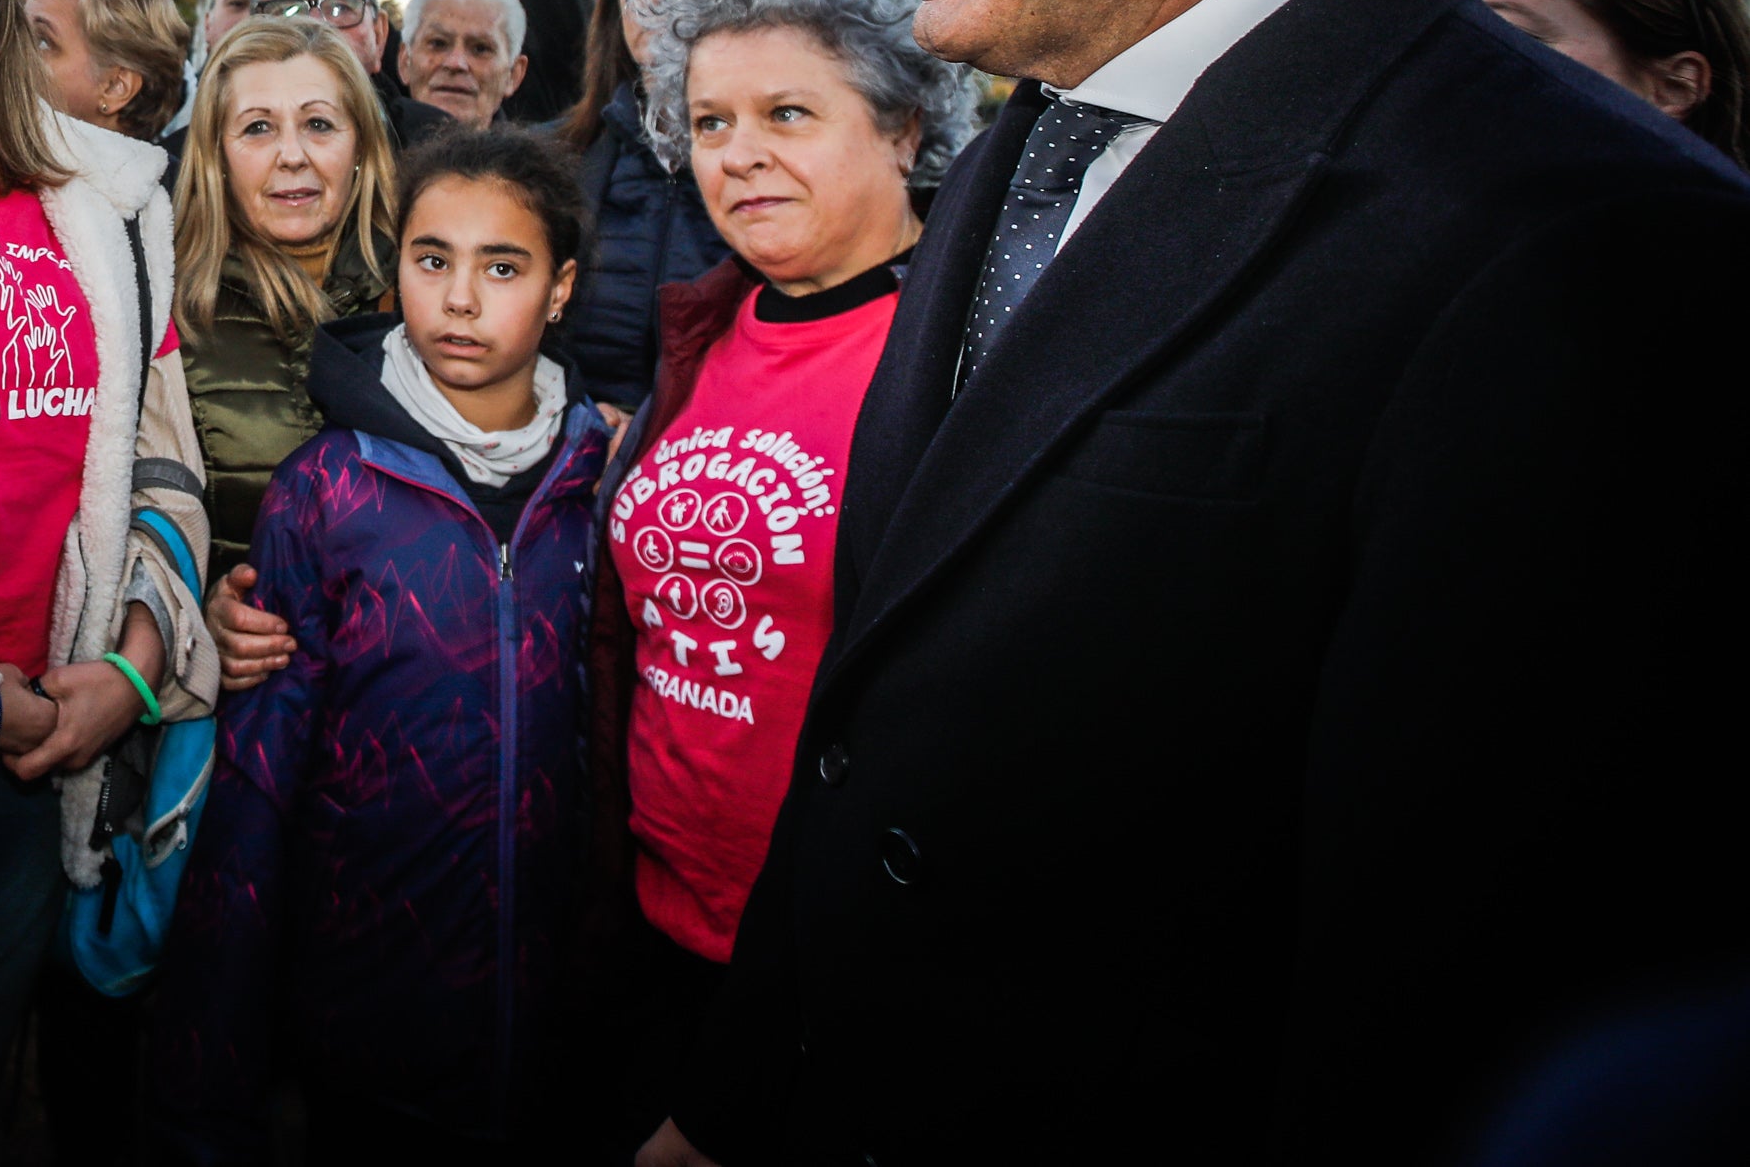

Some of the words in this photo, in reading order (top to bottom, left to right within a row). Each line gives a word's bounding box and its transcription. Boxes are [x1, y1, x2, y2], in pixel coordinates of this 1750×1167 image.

[610, 452, 805, 565] SUBROGACIÓN
[654, 426, 734, 465] única
[739, 428, 835, 518] solución:
[643, 665, 755, 725] GRANADA
